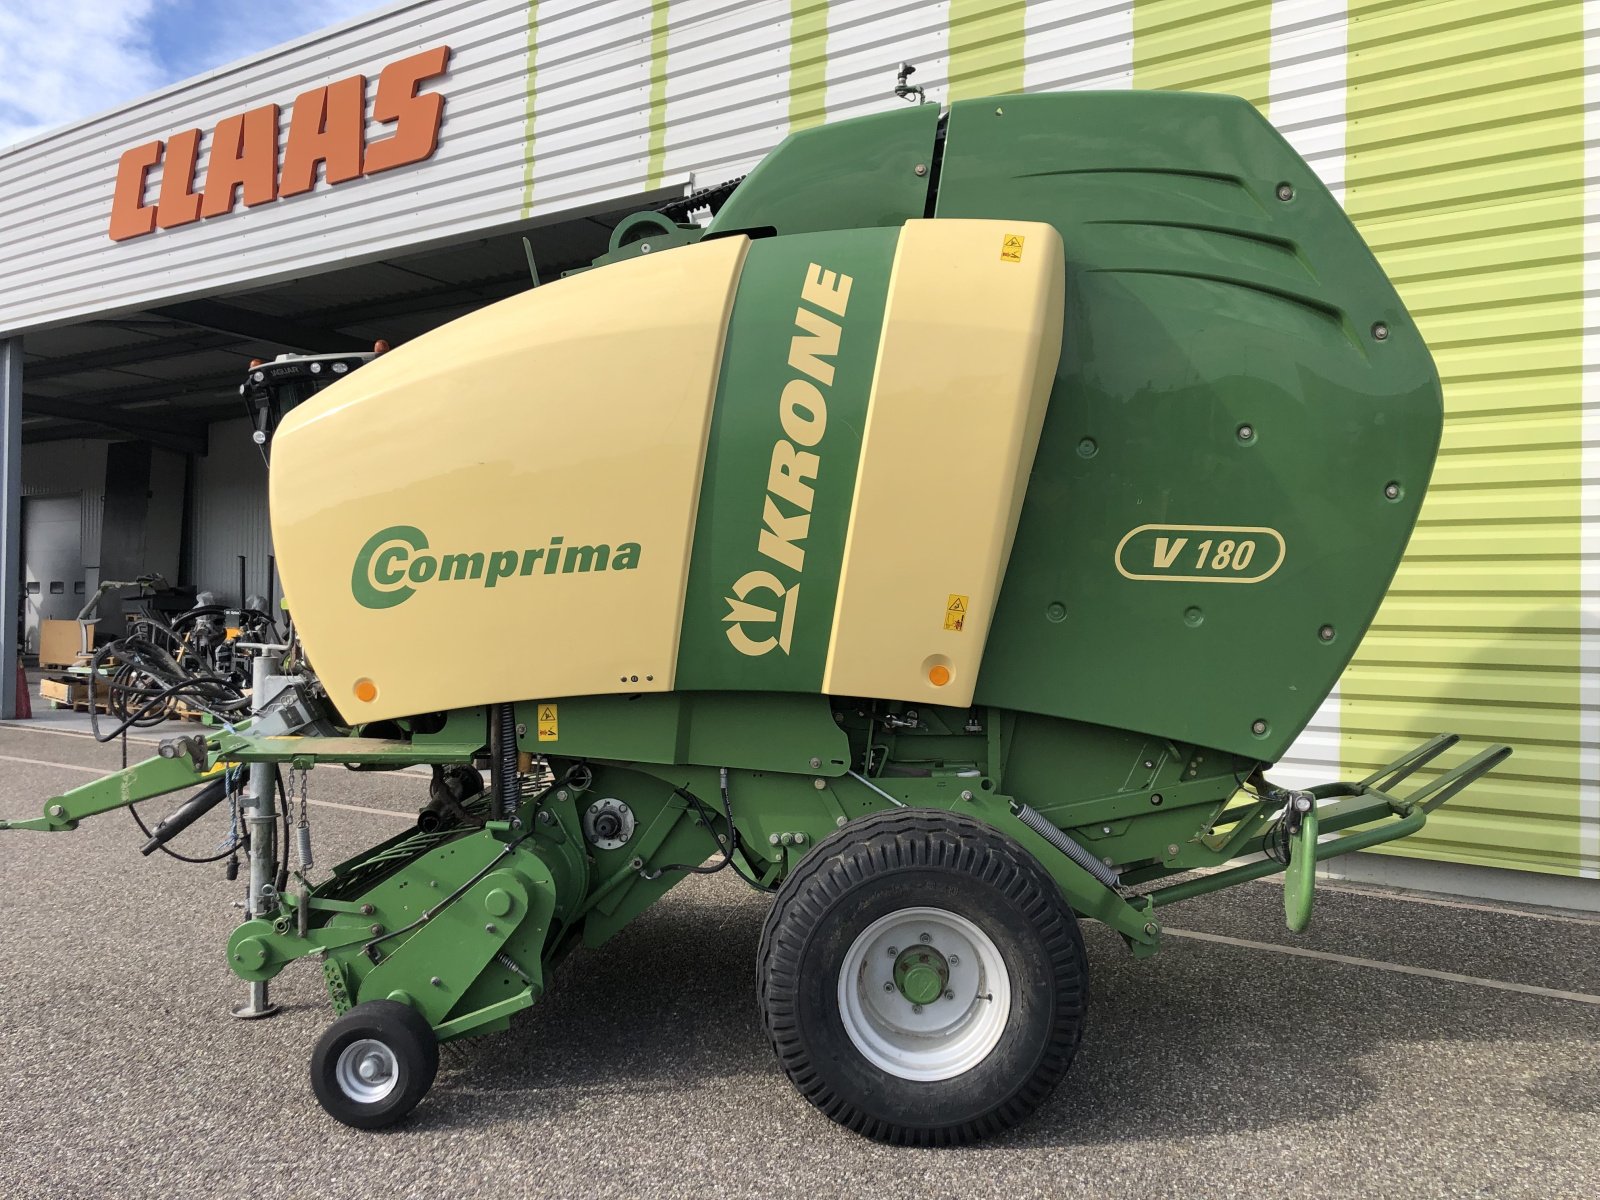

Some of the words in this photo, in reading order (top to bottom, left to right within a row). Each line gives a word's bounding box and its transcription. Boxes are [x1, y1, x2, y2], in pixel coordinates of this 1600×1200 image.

[109, 45, 450, 241] CLAAS
[758, 262, 853, 572] KRONE
[351, 525, 642, 609] Comprima
[1153, 537, 1189, 568] V
[1195, 539, 1256, 571] 180
